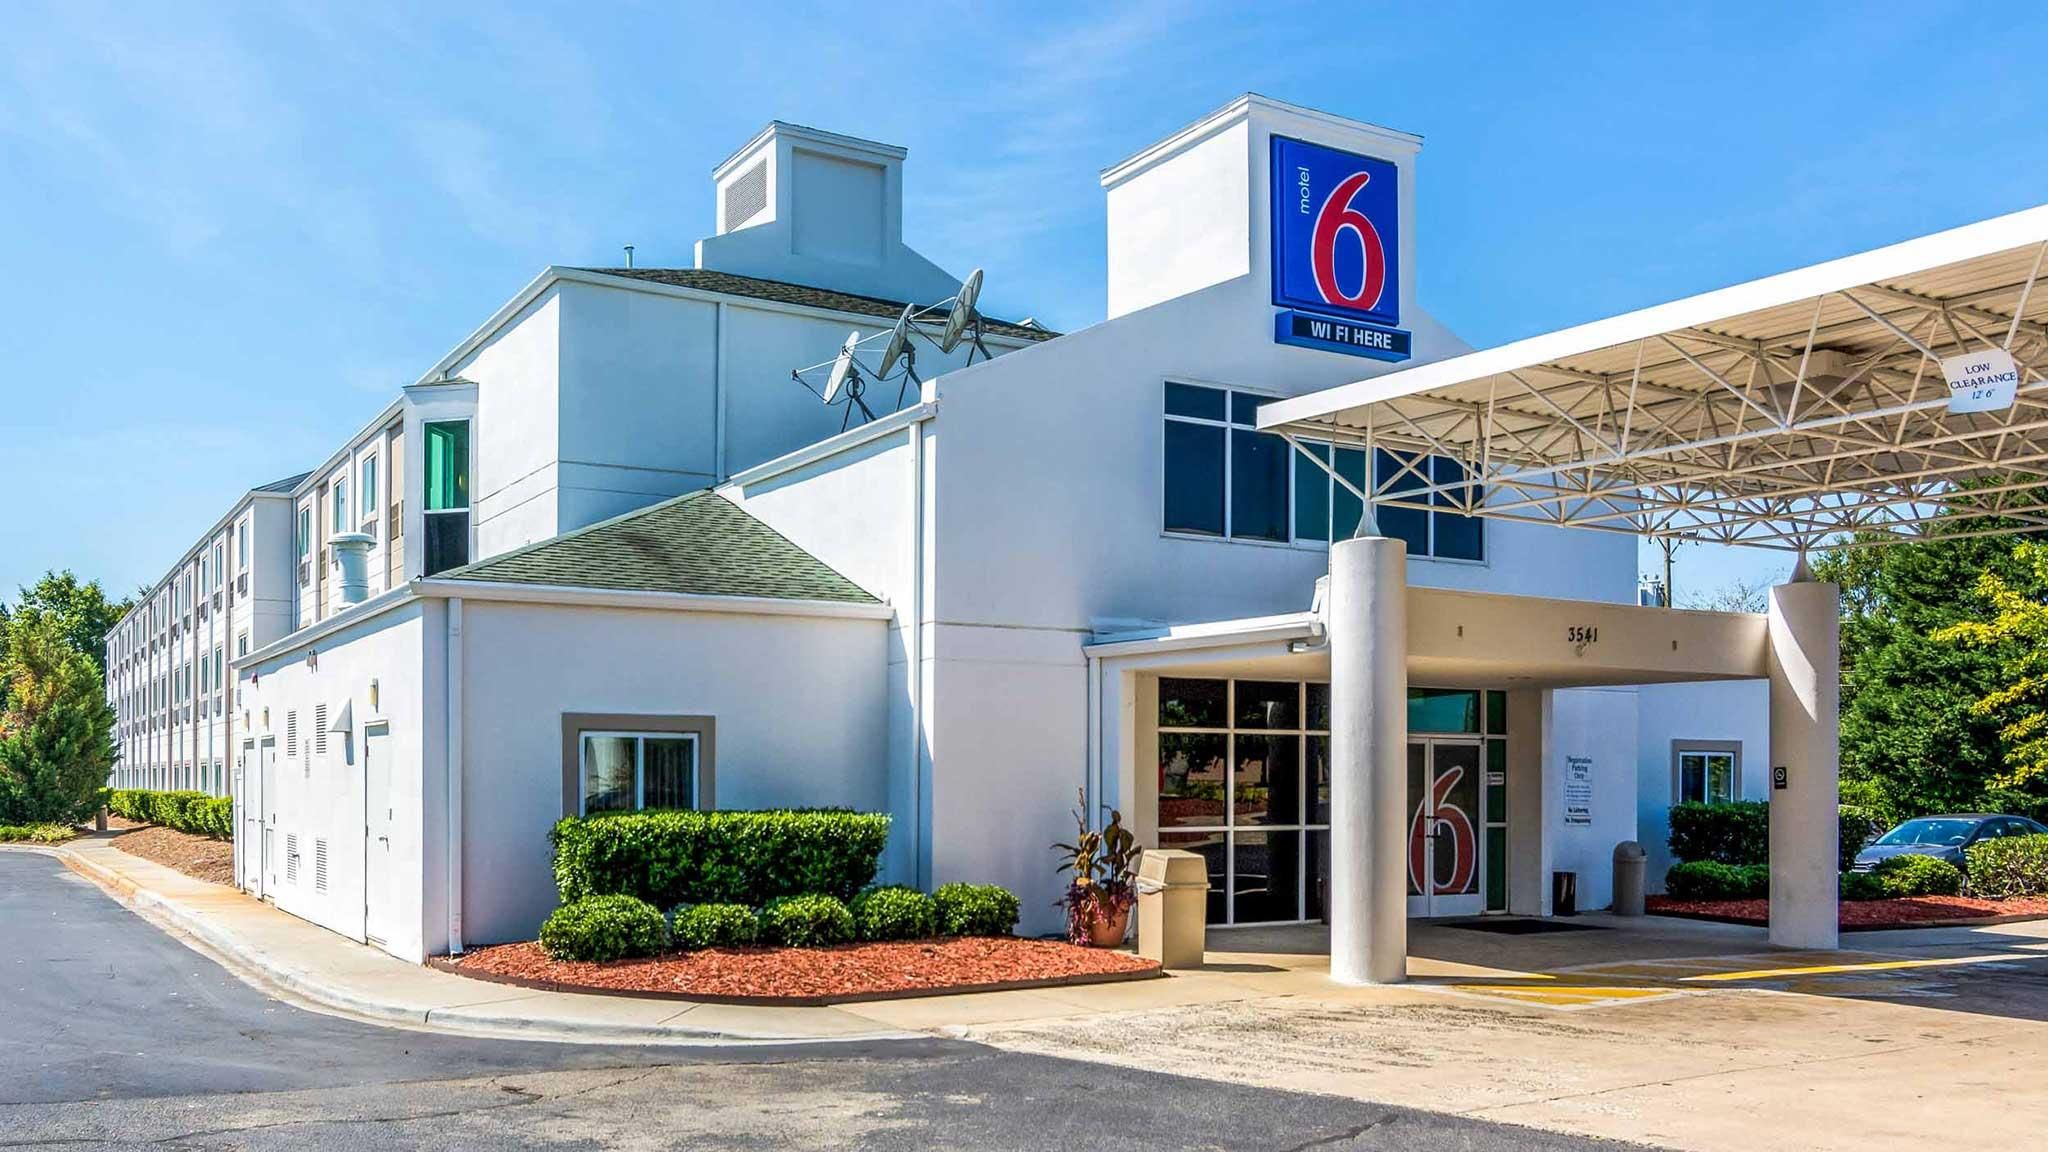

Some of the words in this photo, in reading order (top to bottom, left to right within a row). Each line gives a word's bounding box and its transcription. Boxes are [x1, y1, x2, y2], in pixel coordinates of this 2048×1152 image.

[1298, 166, 1310, 214] motel
[1311, 171, 1386, 311] 6
[1311, 320, 1331, 339] WI
[1336, 325, 1349, 342] FI
[1354, 328, 1392, 349] HERE
[1964, 363, 1991, 375] LOW
[1950, 372, 2016, 390] CLEARANCE
[1568, 627, 1598, 642] 3541
[1409, 765, 1476, 894] 6
